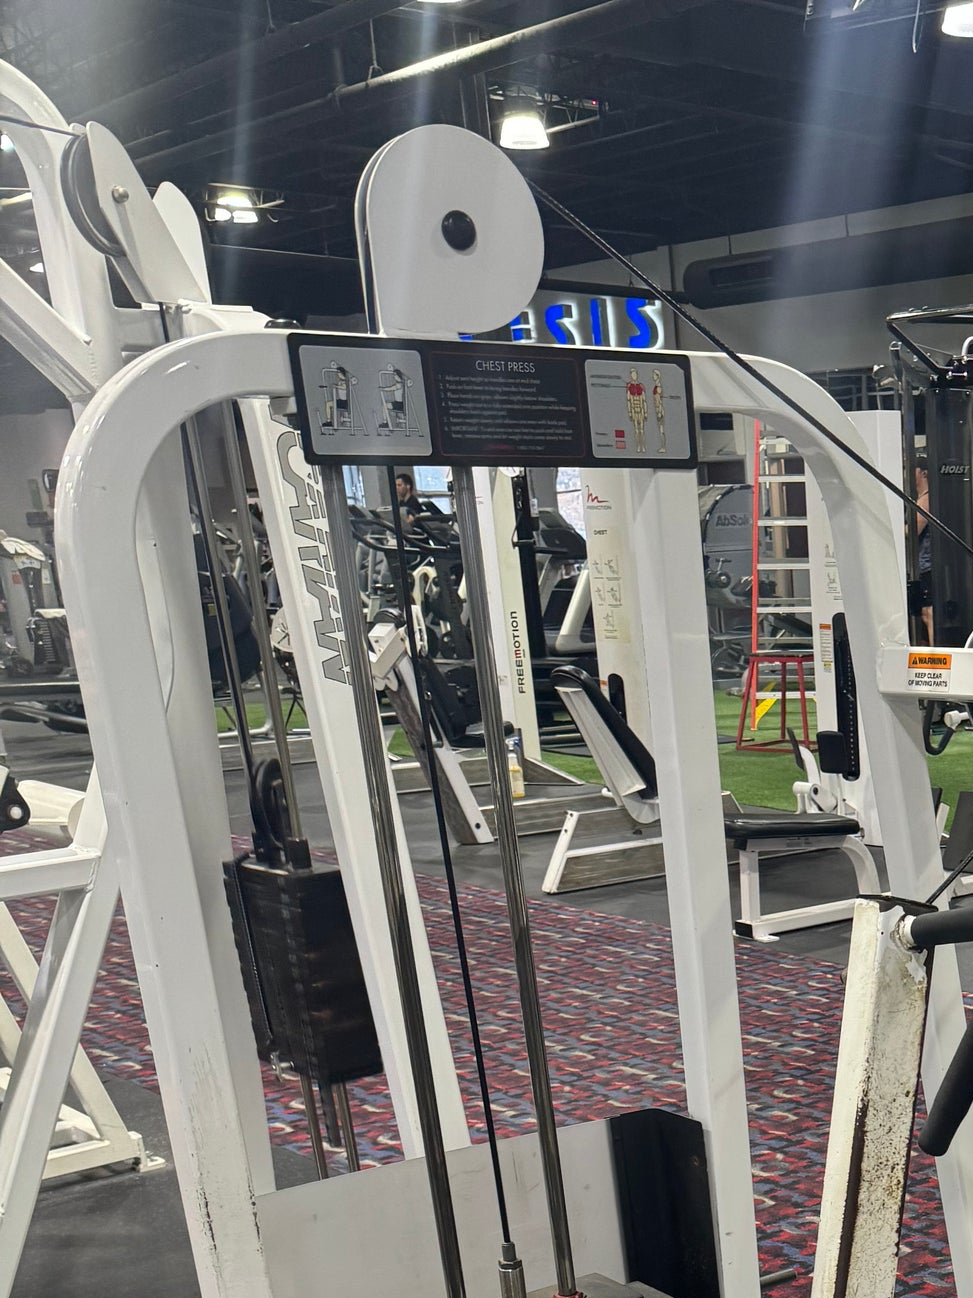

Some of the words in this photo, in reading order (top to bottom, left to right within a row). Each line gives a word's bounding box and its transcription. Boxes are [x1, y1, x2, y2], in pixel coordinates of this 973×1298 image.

[475, 359, 505, 372] CHEST
[508, 361, 536, 373] PRESS
[940, 464, 970, 475] HOIST
[918, 656, 947, 665] WARNING
[927, 672, 942, 680] CLEAR
